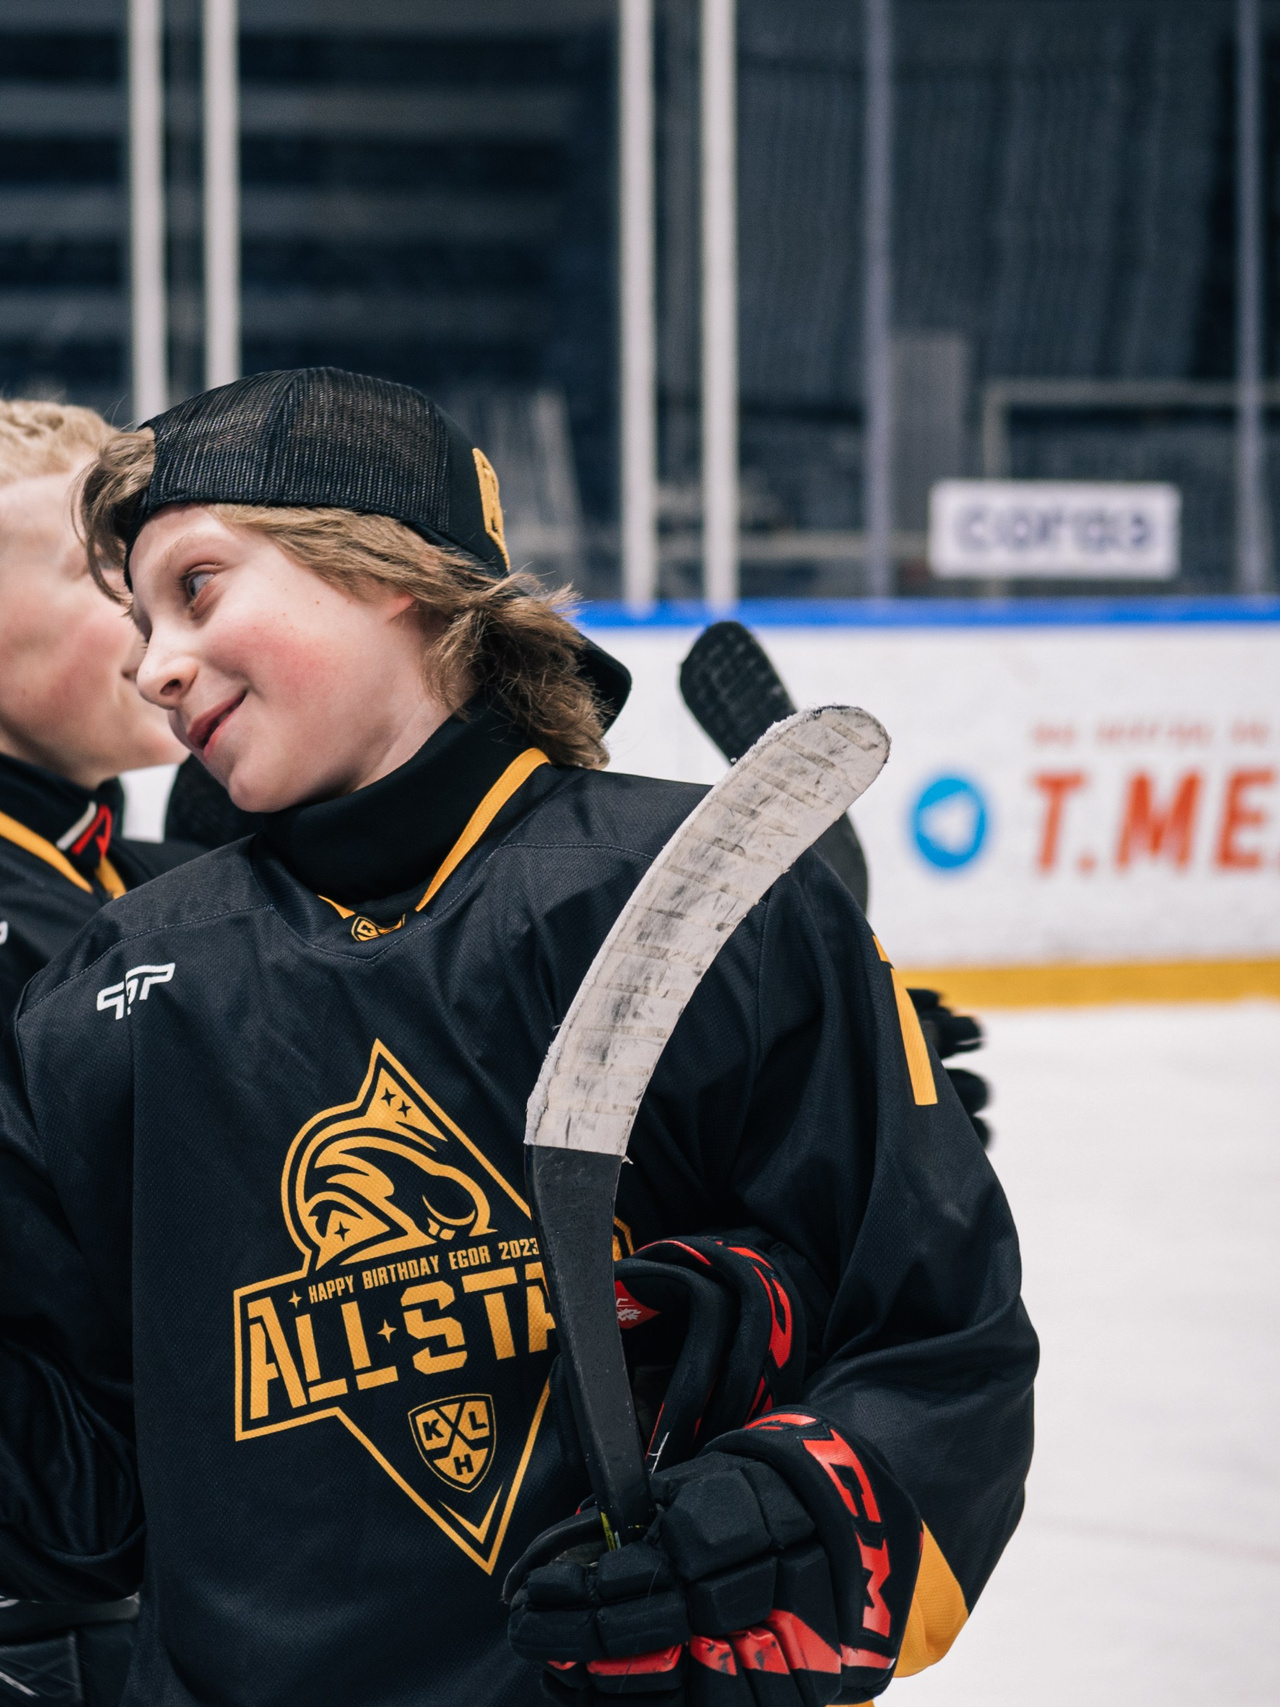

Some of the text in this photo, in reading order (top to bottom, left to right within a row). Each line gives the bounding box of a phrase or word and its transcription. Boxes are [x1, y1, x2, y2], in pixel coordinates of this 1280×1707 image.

[308, 1237, 541, 1304] HAPPY BIRTHDAY EGOR 2023
[400, 1261, 557, 1375] STA
